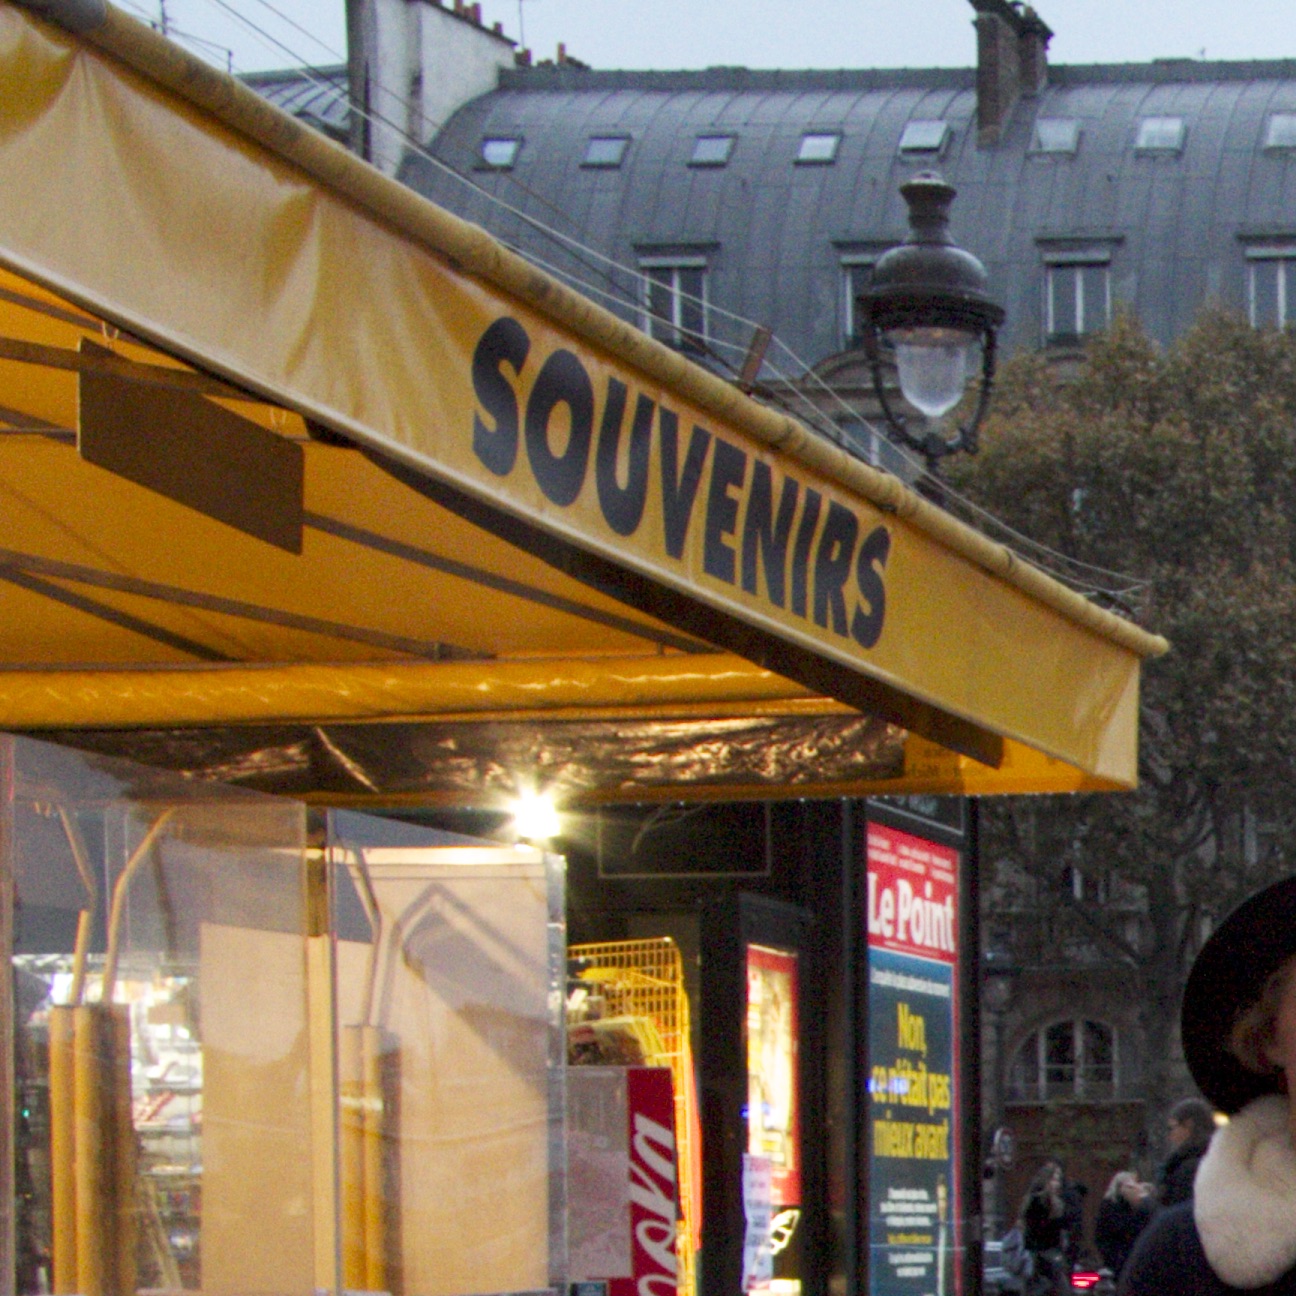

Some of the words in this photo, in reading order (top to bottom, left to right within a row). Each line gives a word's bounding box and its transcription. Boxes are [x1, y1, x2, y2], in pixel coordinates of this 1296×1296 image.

[471, 317, 892, 649] SOUVENIRS
[867, 871, 895, 938] Le
[896, 877, 956, 955] Point
[896, 1002, 928, 1060] Non,
[928, 1072, 950, 1116] pas
[873, 1109, 914, 1158] mieux
[914, 1117, 949, 1161] avant
